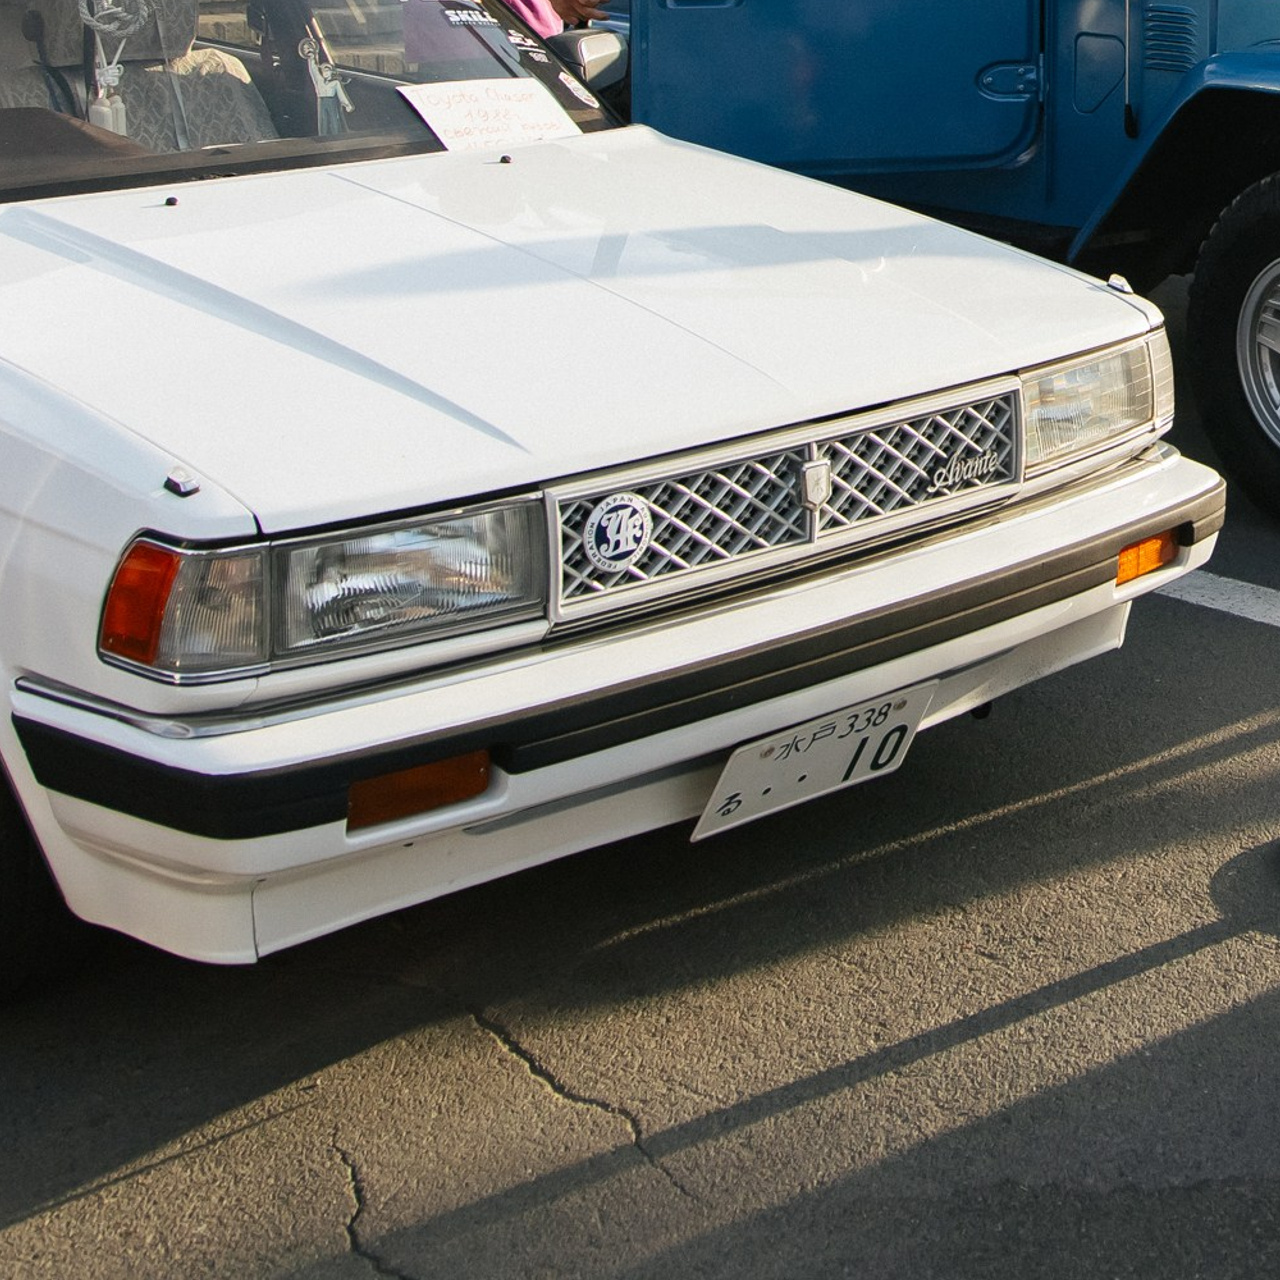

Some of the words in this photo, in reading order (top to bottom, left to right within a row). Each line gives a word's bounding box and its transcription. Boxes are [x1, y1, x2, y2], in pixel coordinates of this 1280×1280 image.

[926, 449, 999, 493] Avante
[600, 495, 634, 512] JAPAN
[587, 522, 618, 570] FEDERATION
